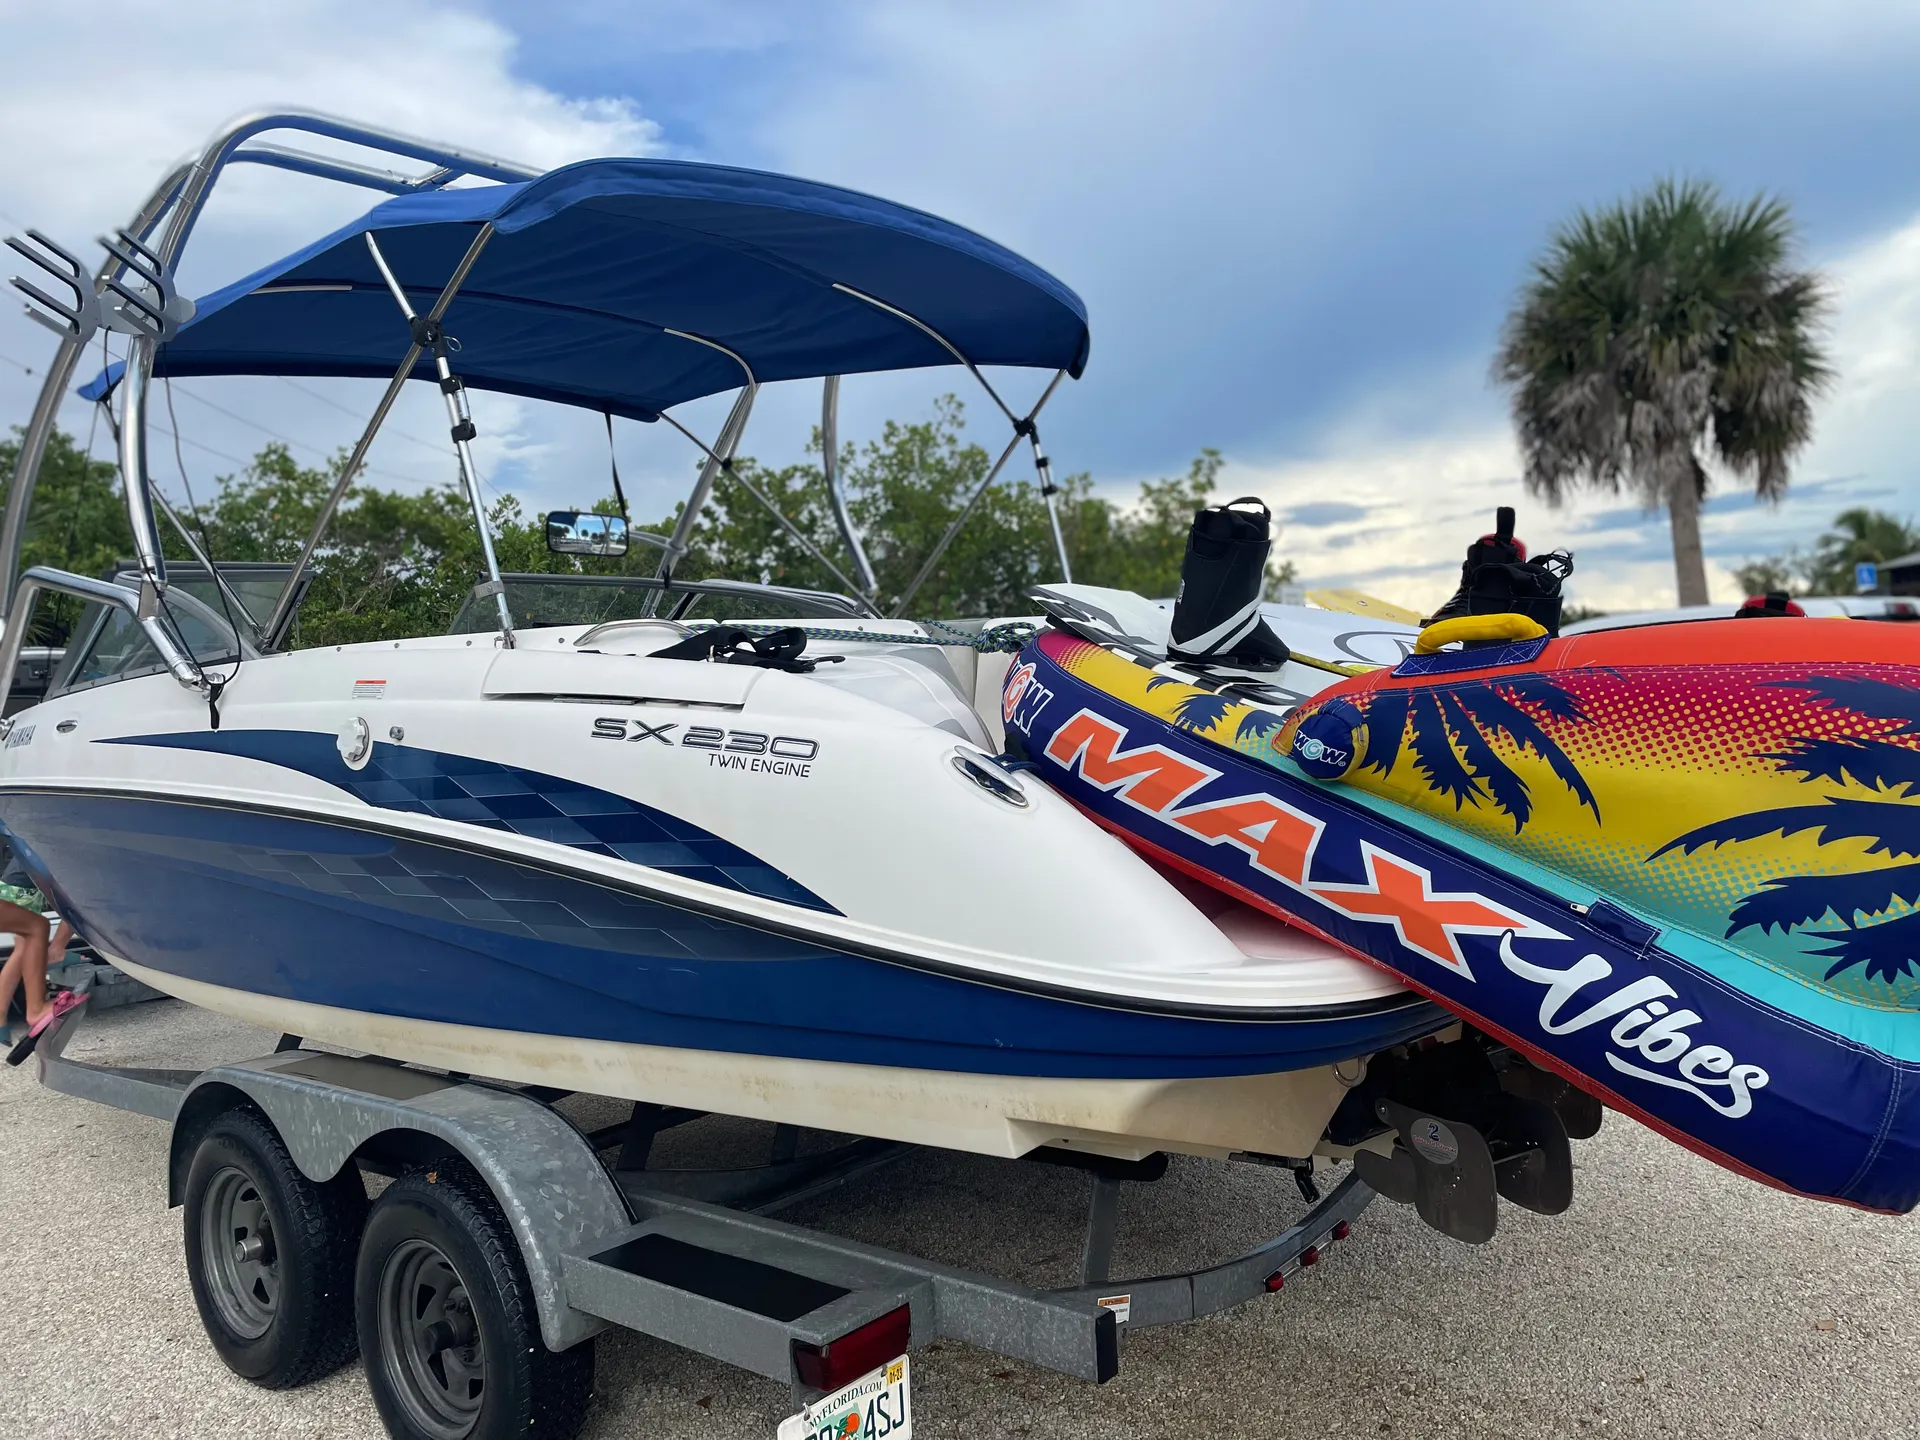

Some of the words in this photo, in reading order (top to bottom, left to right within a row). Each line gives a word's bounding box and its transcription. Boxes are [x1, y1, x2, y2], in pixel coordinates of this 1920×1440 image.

[590, 716, 679, 747] SX
[681, 725, 821, 762] 230
[708, 753, 747, 770] TWIN
[750, 758, 811, 778] ENGINE
[1042, 707, 1574, 983] MAX
[1499, 931, 1770, 1118] Vibes
